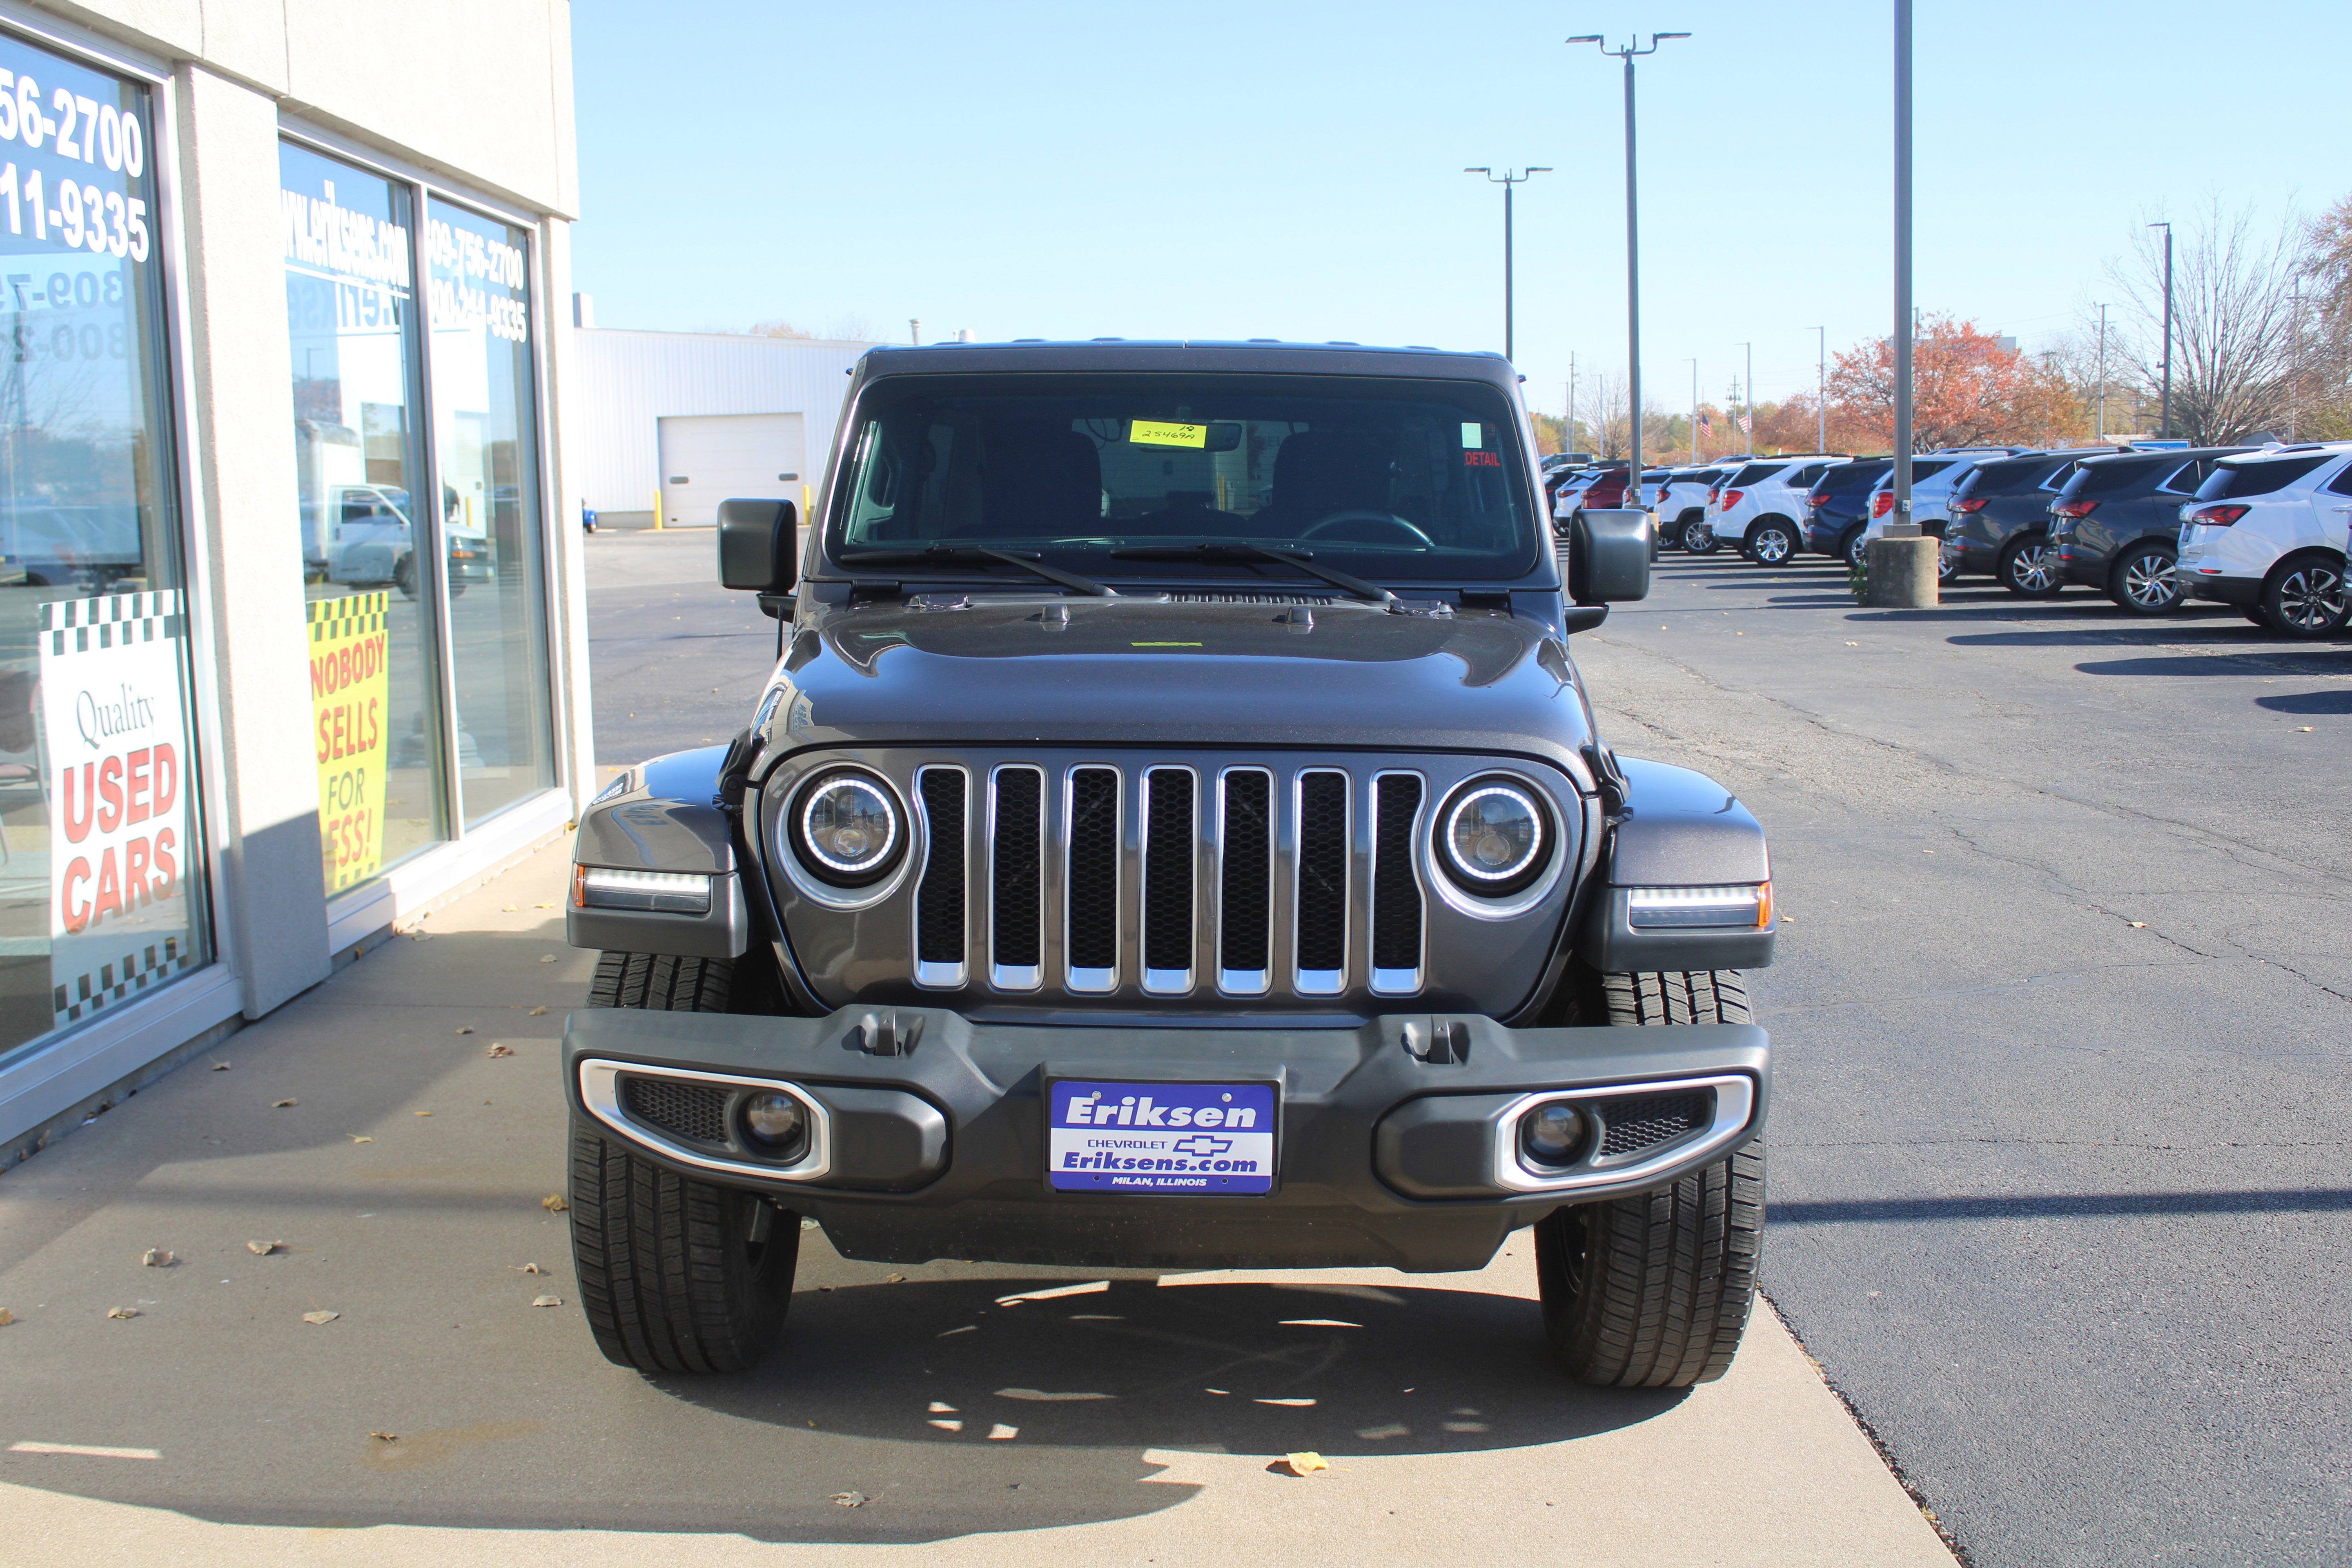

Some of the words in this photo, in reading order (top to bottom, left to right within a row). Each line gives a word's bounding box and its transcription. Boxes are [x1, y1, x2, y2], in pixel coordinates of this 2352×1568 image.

[1465, 452, 1501, 466] DETAIL
[310, 633, 384, 700] NOBODY
[77, 682, 154, 749] Quality
[318, 697, 377, 763] SELLS
[63, 742, 176, 844] USED
[327, 768, 364, 815] FOR
[62, 827, 176, 936] CARS
[1065, 1096, 1256, 1127] Eriksen
[1063, 1152, 1258, 1172] Eriksens.com
[1088, 1139, 1168, 1149] CHEVROLET
[1112, 1176, 1154, 1187] MILAN,
[1156, 1177, 1207, 1187] ILLINOIS
